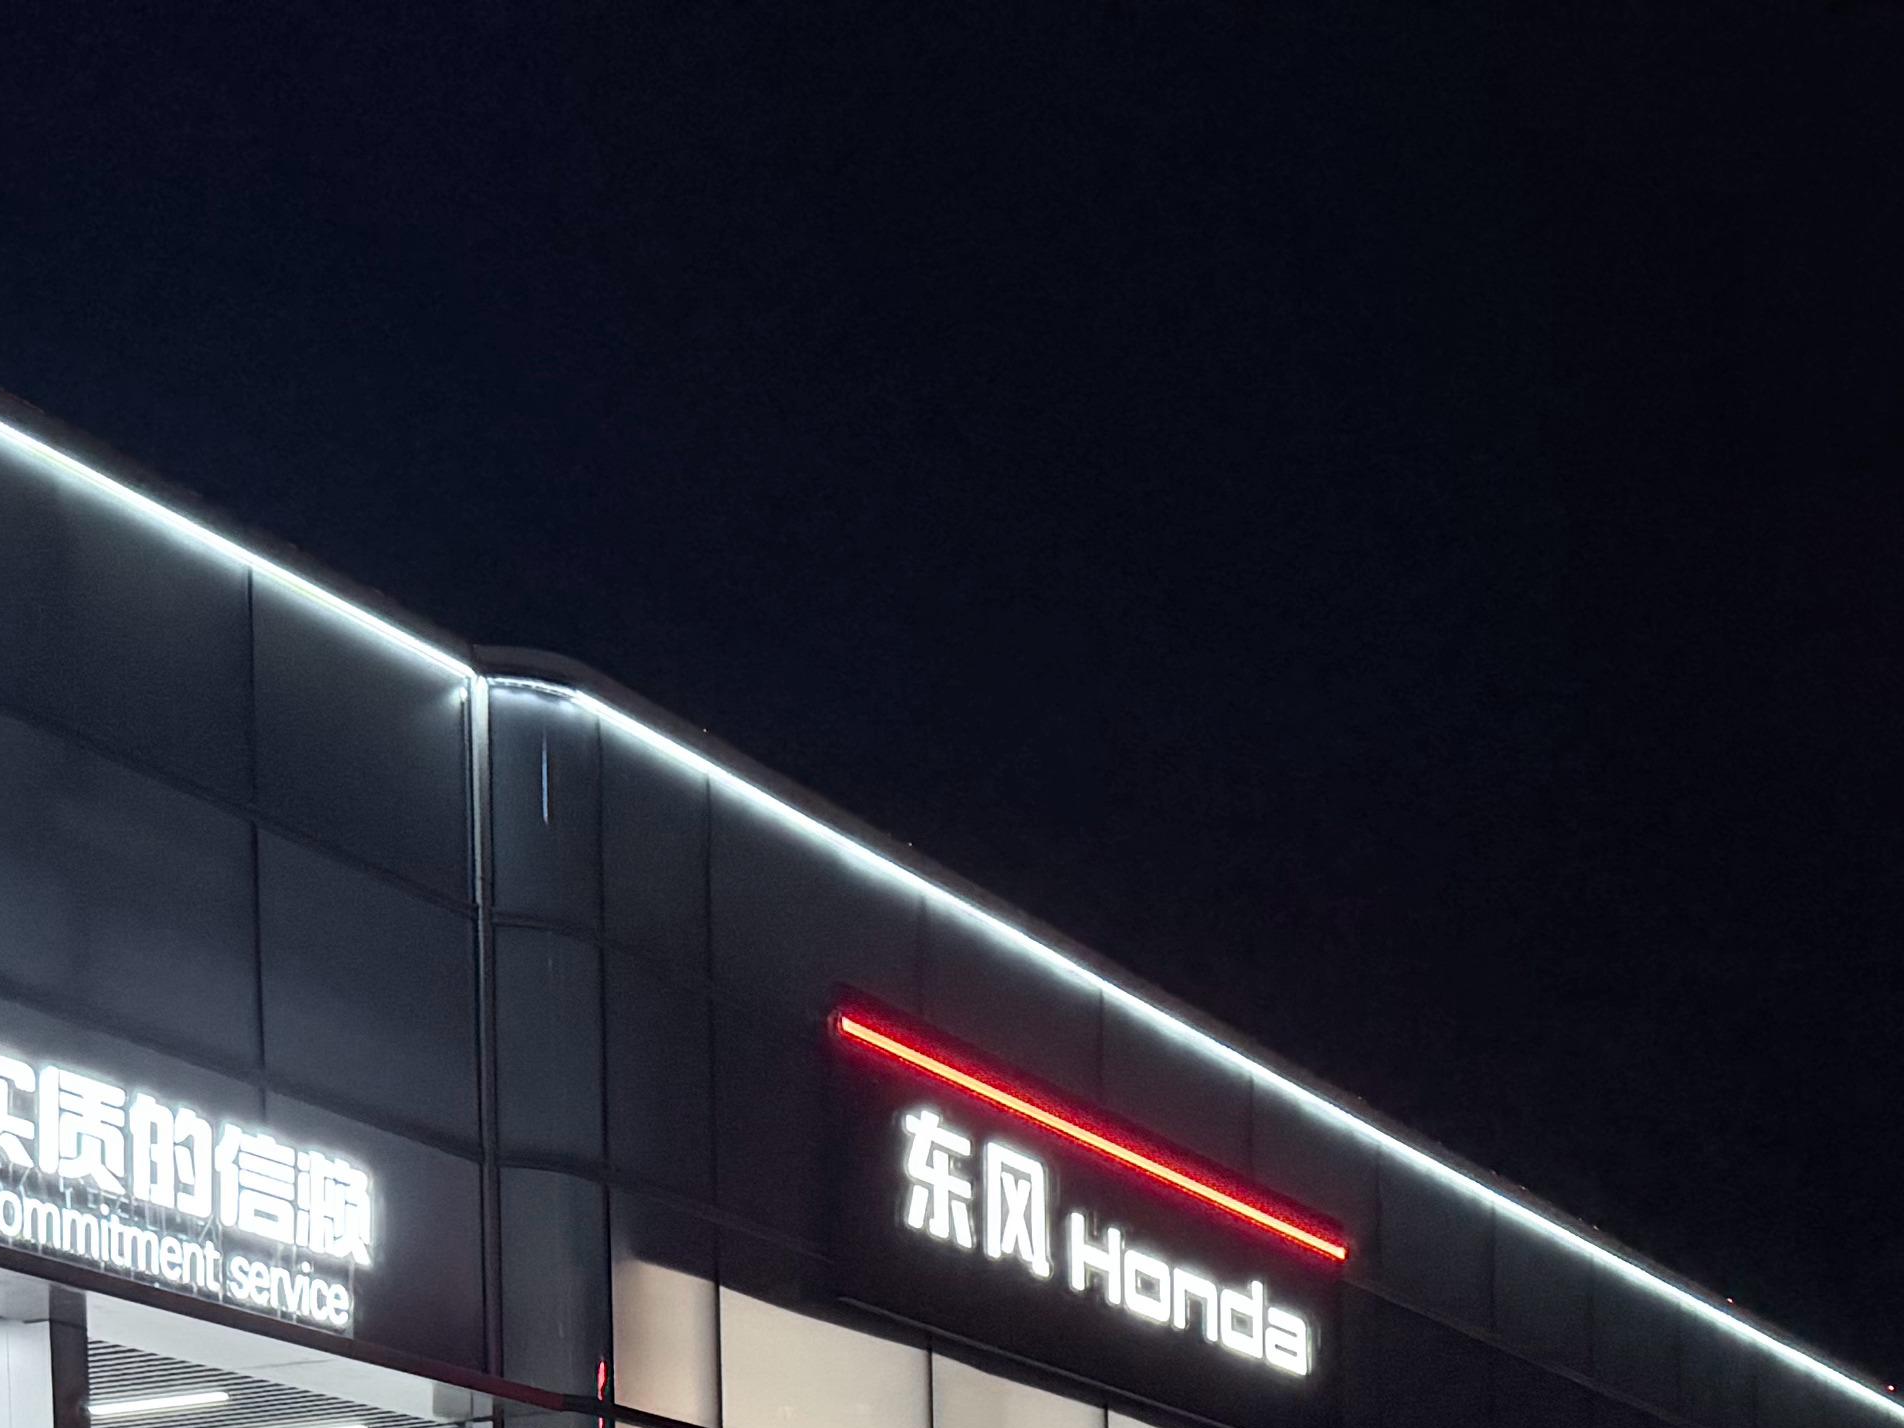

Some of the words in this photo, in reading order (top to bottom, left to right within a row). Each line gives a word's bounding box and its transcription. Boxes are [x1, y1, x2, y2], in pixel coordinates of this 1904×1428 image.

[227, 1253, 350, 1328] service
[903, 1110, 1054, 1280] 东风
[1068, 1211, 1316, 1377] Honda
